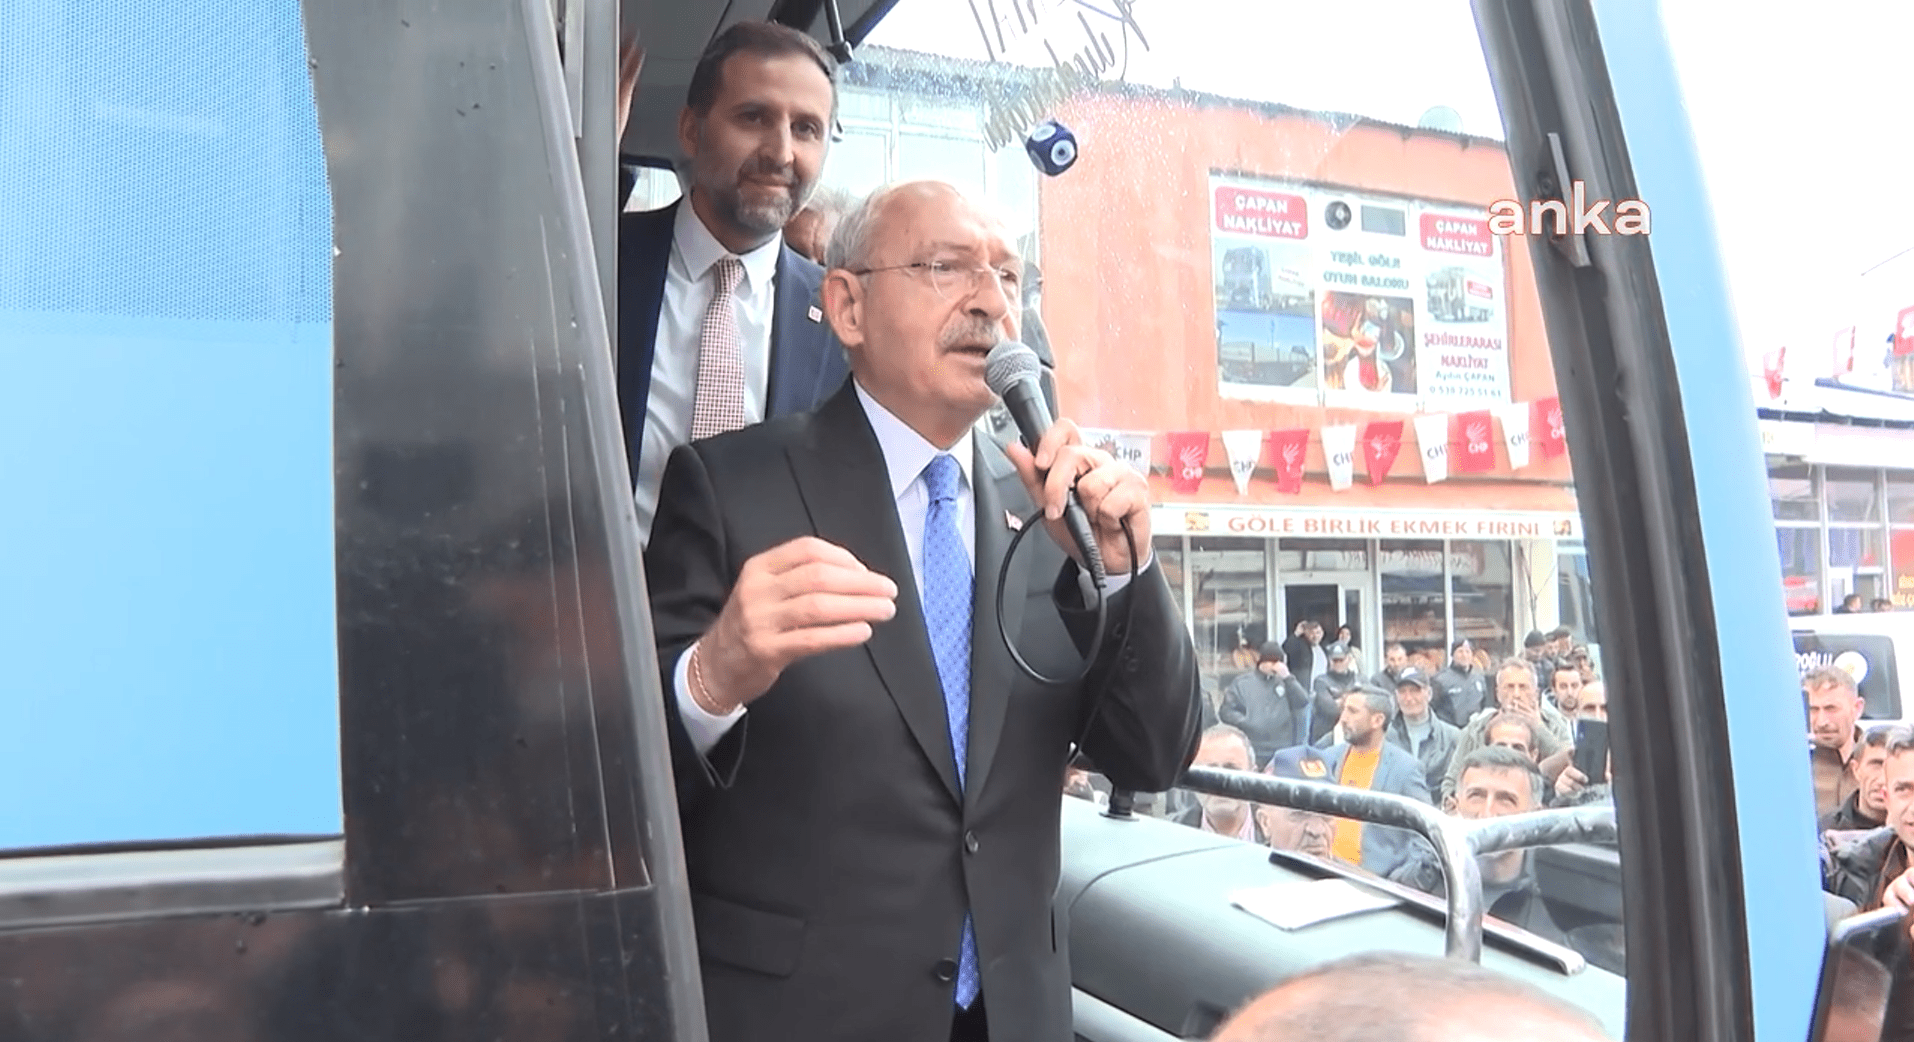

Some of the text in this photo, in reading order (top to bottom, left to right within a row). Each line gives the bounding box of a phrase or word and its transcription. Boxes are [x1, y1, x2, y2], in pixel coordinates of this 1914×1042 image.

[1235, 194, 1288, 213] ÇAPAN
[1223, 213, 1301, 237] NAKLİYAT
[1435, 220, 1477, 236] ÇAPAN
[1427, 236, 1488, 255] NAKLİYAT
[1116, 446, 1142, 462] CHP
[1227, 513, 1539, 536] GÖLE BİRLİK EKMEK FIRINI
